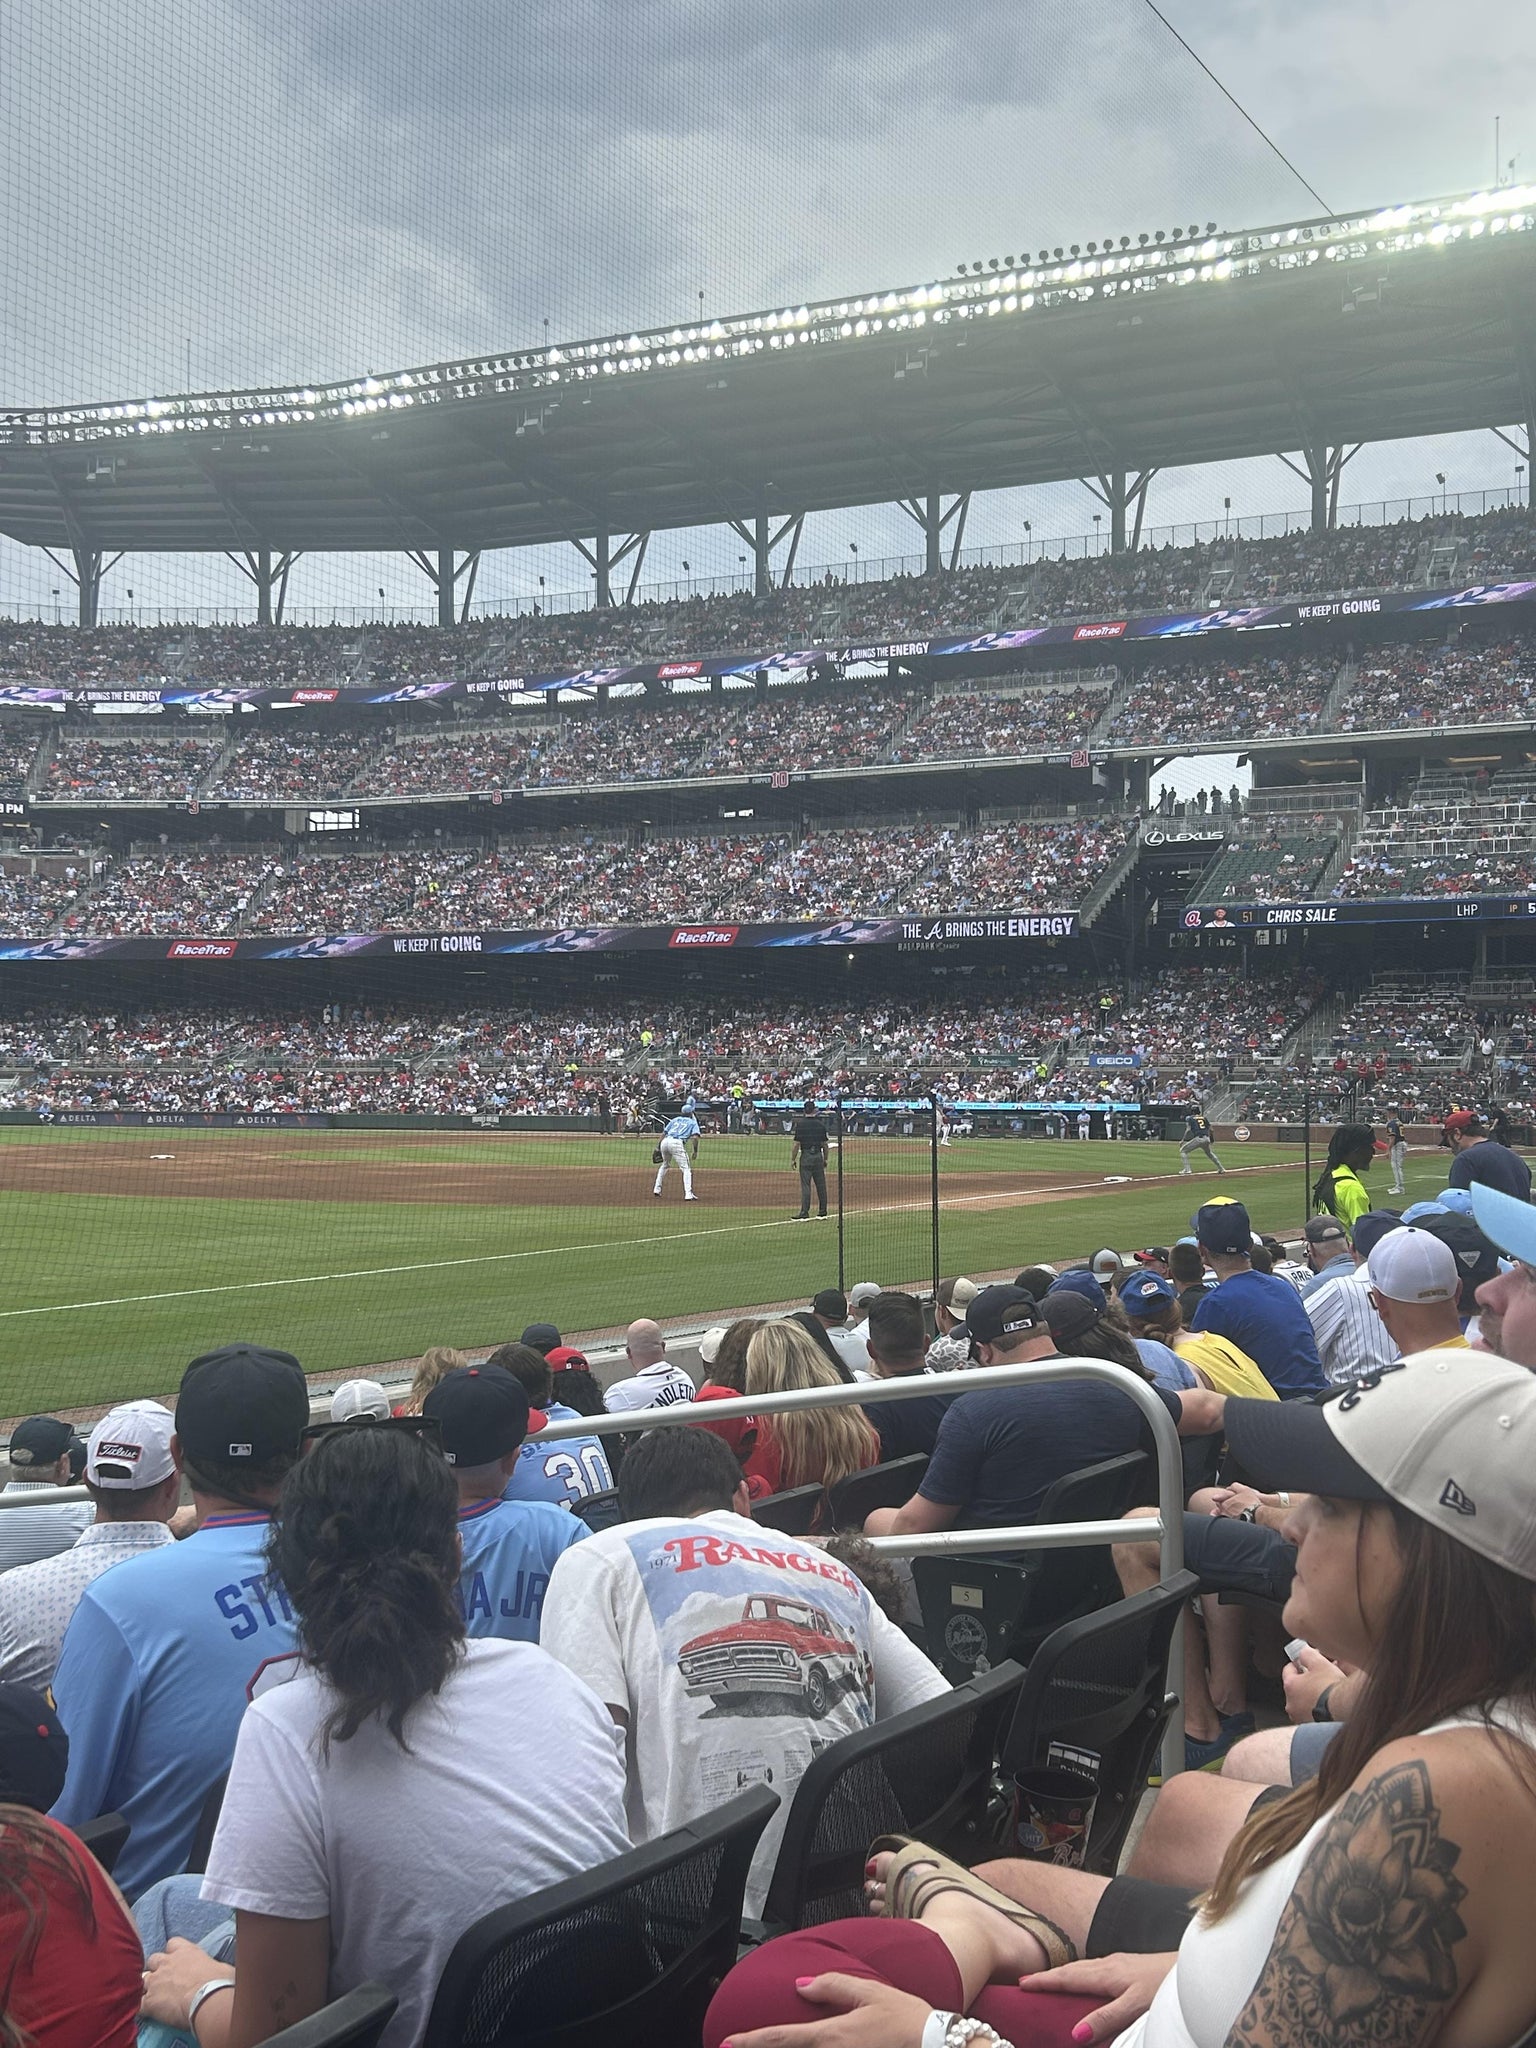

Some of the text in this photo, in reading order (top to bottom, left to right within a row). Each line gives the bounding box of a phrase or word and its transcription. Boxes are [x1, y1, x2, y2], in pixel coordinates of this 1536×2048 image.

[1298, 599, 1381, 618] WE KEEP IT GOING
[1078, 625, 1121, 639] RaceTrac
[825, 651, 838, 662] THE
[851, 648, 876, 660] BRINGS
[876, 646, 889, 657] THE
[889, 642, 930, 657] ENERGY
[661, 664, 699, 676] RaceTrac
[466, 678, 525, 693] WE KEEP IT GOING
[62, 691, 74, 701] THE
[87, 692, 111, 701] BRINGS
[111, 691, 123, 701] THE
[123, 690, 162, 702] ENERGY
[295, 692, 335, 701] RaceTrac
[1071, 750, 1089, 768] 21
[771, 771, 789, 789] 10
[492, 789, 503, 805] 6
[5, 803, 24, 814] PM
[188, 800, 200, 815] 3
[1166, 831, 1224, 843] LEXUS
[1242, 911, 1253, 923] 51
[1266, 908, 1303, 924] CHRIS
[1305, 908, 1338, 922] SALE
[1456, 903, 1478, 917] LHP
[1509, 904, 1518, 913] IP
[902, 923, 922, 939] THE
[945, 921, 984, 938] BRINGS
[985, 920, 1006, 936] THE
[1008, 917, 1074, 937] ENERGY
[394, 935, 482, 953] WE KEEP IT GOING
[675, 931, 732, 944] RaceTrac
[173, 944, 232, 956] RaceTrac
[1096, 1057, 1133, 1066] GEICO
[68, 1114, 96, 1122] DELTA
[156, 1115, 185, 1123] DELTA
[247, 1116, 277, 1124] DELTA
[671, 1122, 688, 1133] 27
[99, 1444, 138, 1459] Titleist
[650, 1554, 677, 1570] 1971
